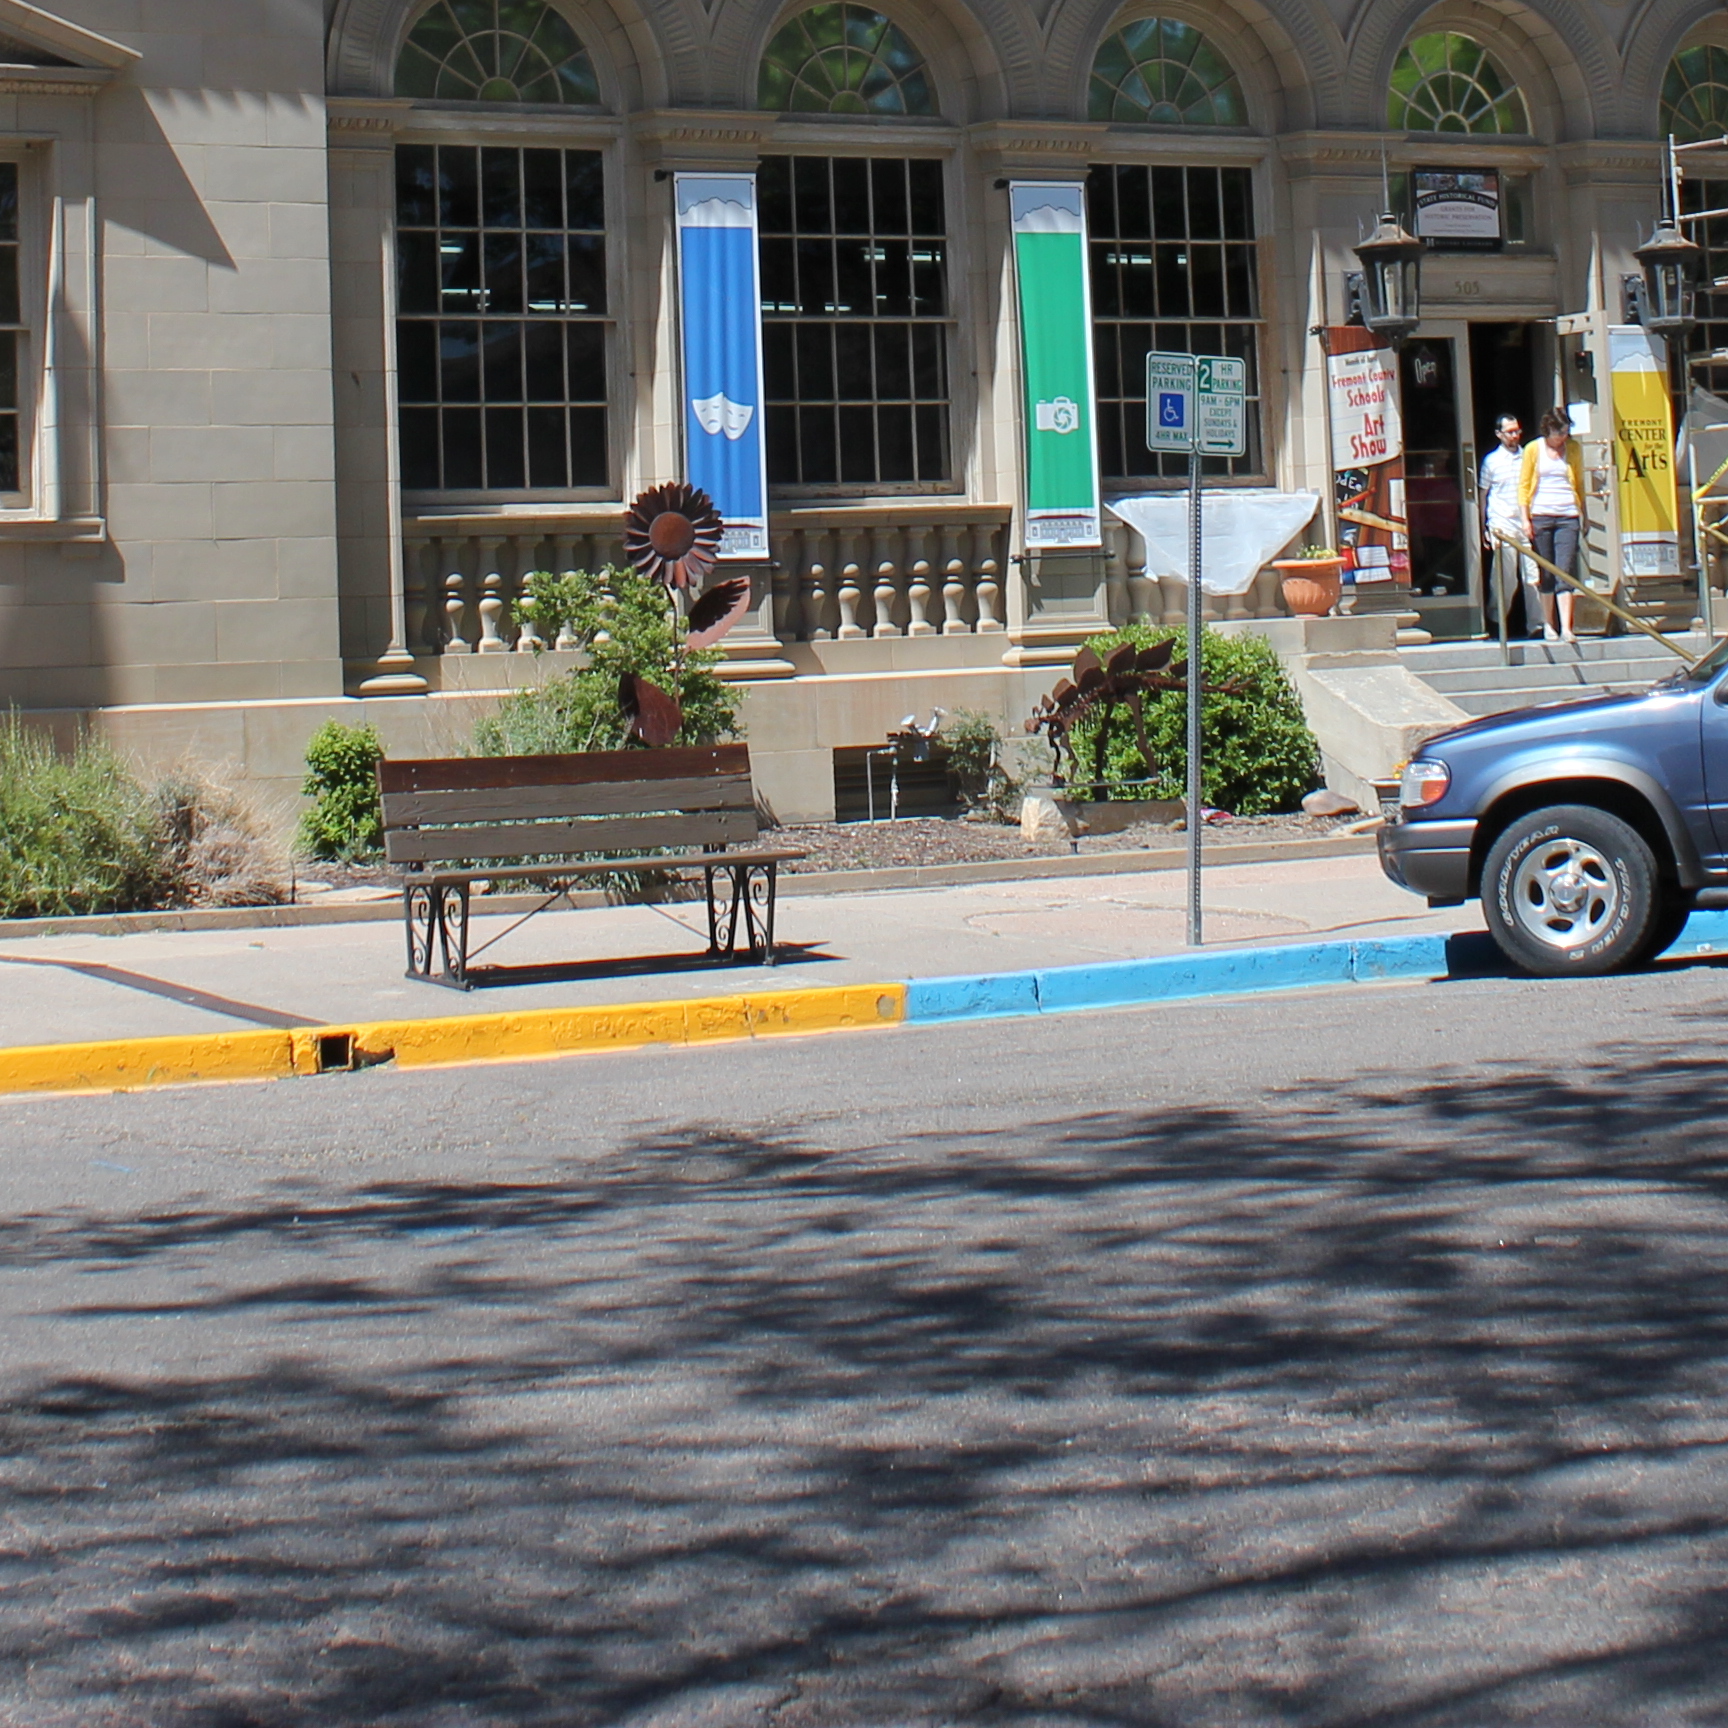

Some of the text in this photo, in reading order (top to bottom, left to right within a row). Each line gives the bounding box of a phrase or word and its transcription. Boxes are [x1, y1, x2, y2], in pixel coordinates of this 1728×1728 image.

[1418, 192, 1497, 207] STATE HISTORICAL FUND
[1454, 280, 1480, 295] 505
[1152, 362, 1192, 376] RESERVED
[1199, 364, 1210, 388] 2
[1221, 363, 1234, 375] HR
[1152, 376, 1192, 391] PARKING
[1212, 378, 1243, 391] PARKING
[1332, 367, 1396, 389] Fremont County
[1200, 396, 1217, 405] 9AM
[1224, 397, 1241, 406] 6PM
[1346, 385, 1386, 408] Schools
[1209, 408, 1233, 417] EXCEPT
[1203, 418, 1232, 428] SUNDAYS
[1363, 412, 1386, 438] Art
[1155, 432, 1189, 442] 4HR MAX
[1205, 429, 1236, 439] HOLIDAYS
[1618, 428, 1668, 442] CENTER
[1350, 434, 1388, 460] Show
[1622, 446, 1668, 483] Arts
[1499, 825, 1559, 926] GOODYEAR
